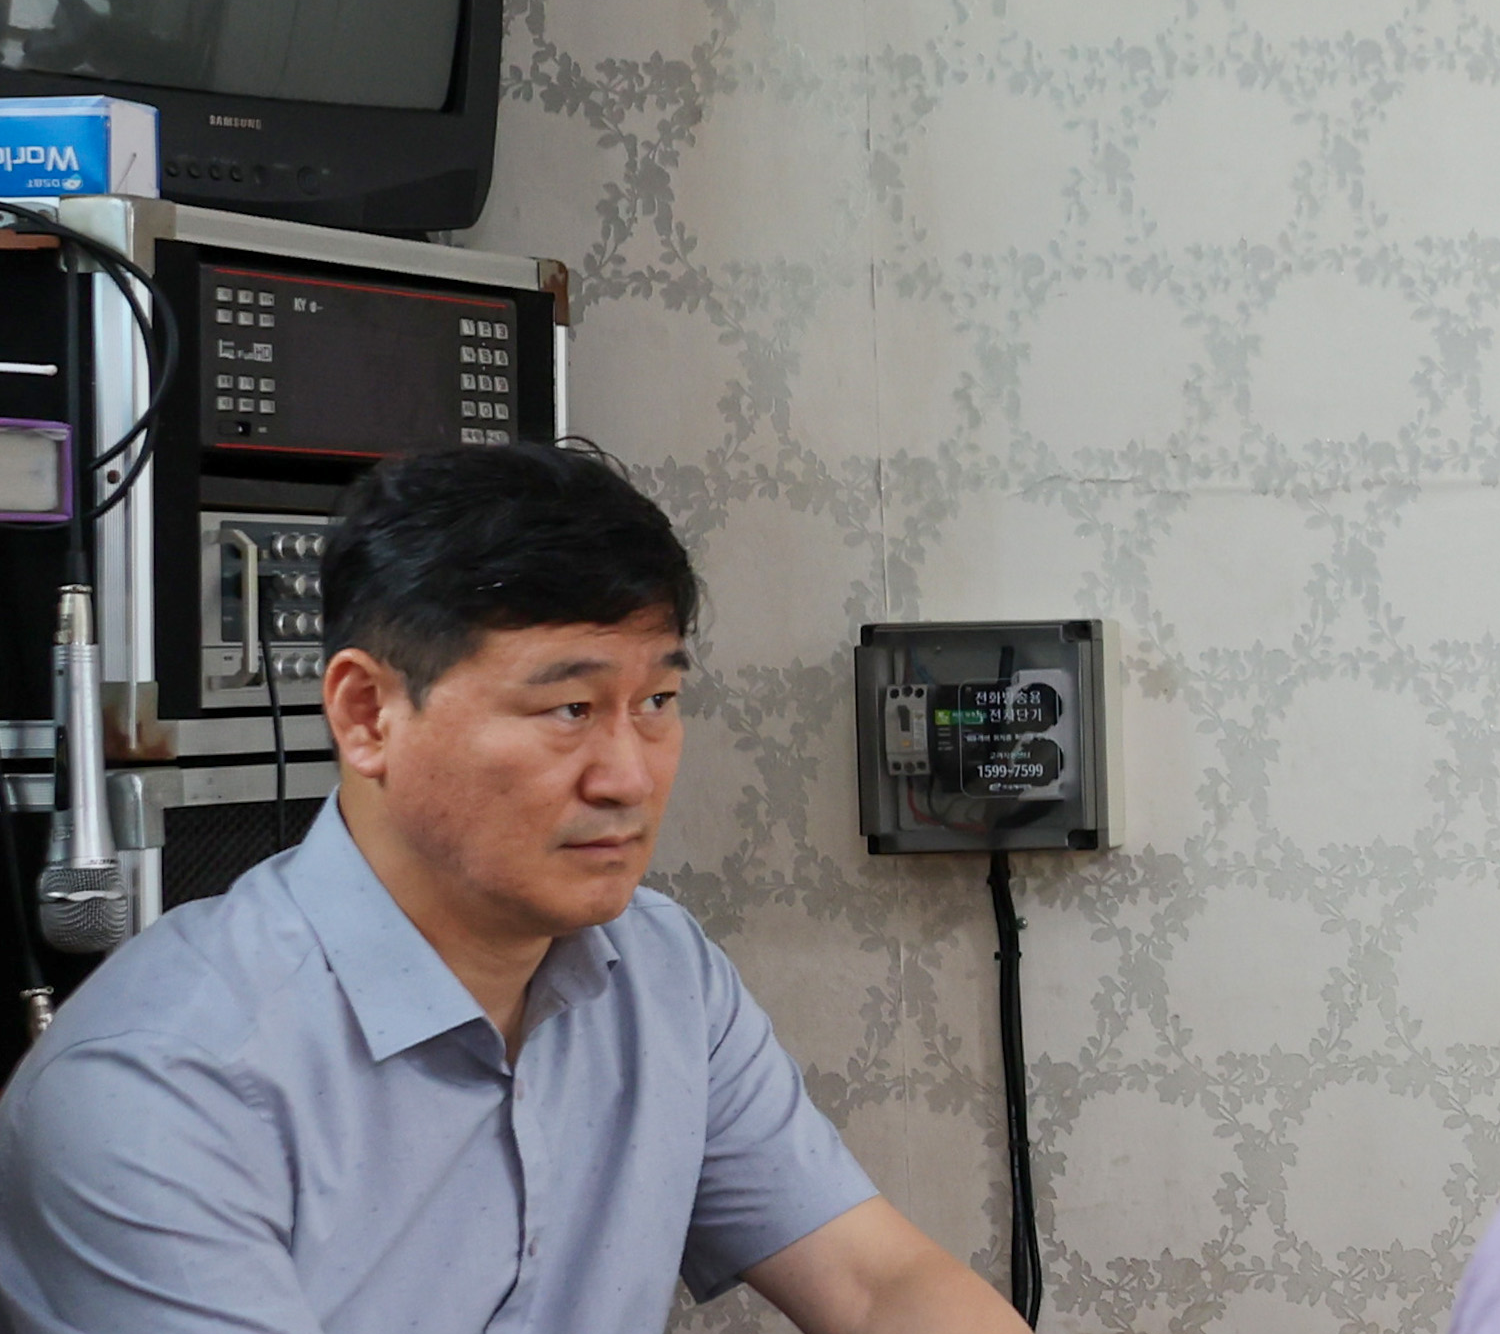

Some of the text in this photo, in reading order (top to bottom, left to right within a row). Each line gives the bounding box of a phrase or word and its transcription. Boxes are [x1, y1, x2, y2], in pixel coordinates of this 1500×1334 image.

[209, 114, 262, 131] SAMSUNG
[0, 145, 79, 172] Worl
[977, 762, 1044, 778] 1599-7599
